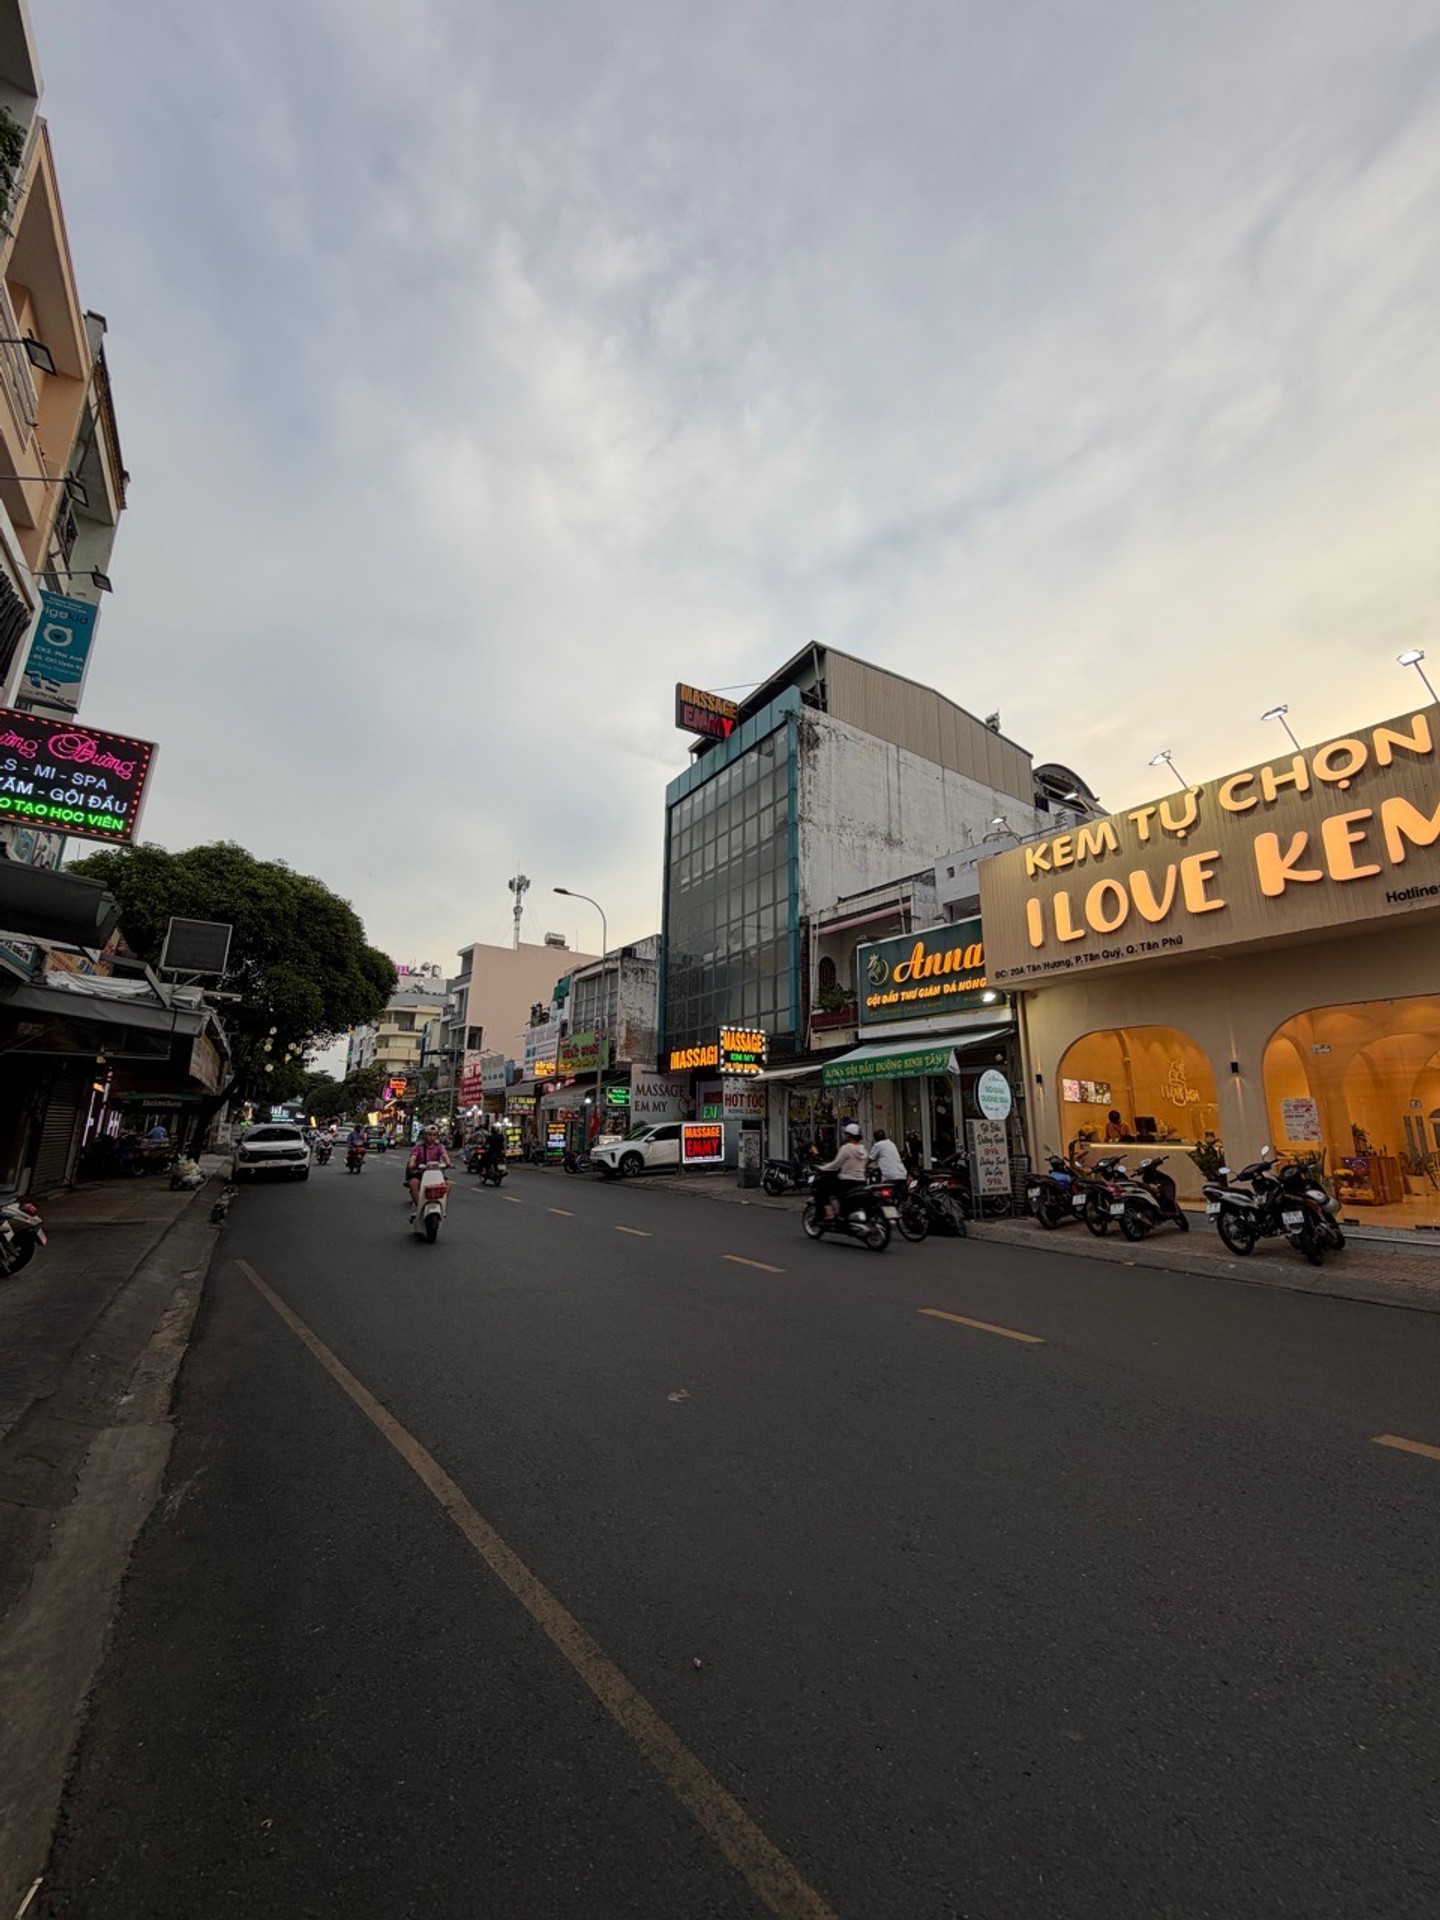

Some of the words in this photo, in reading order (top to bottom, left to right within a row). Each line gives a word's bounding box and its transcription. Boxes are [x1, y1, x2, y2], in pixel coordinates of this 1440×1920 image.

[681, 685, 737, 719] MASSAGE
[34, 764, 56, 780] MI
[71, 772, 108, 790] SPA
[50, 787, 86, 806] GỘI
[1025, 822, 1118, 876] KEM
[1129, 785, 1201, 840] TỰ
[1218, 713, 1433, 812] CHỌN
[14, 799, 48, 815] TẠO
[50, 807, 85, 822] HỌC
[88, 813, 124, 831] VIÊN
[1026, 897, 1044, 948] I
[1053, 850, 1226, 942] LOVE
[1254, 796, 1440, 897] KEM
[893, 942, 985, 983] Anna
[1011, 966, 1025, 977] 20A
[1027, 963, 1042, 974] Tân
[1139, 939, 1160, 953] Tân
[1162, 934, 1184, 949] Phú
[866, 993, 881, 1008] GỘI
[723, 1030, 763, 1054] MASSAGE
[635, 1083, 686, 1098] MASSAGE
[634, 1101, 652, 1112] EM
[652, 1101, 668, 1113] MY
[685, 1126, 720, 1138] MASSAGE
